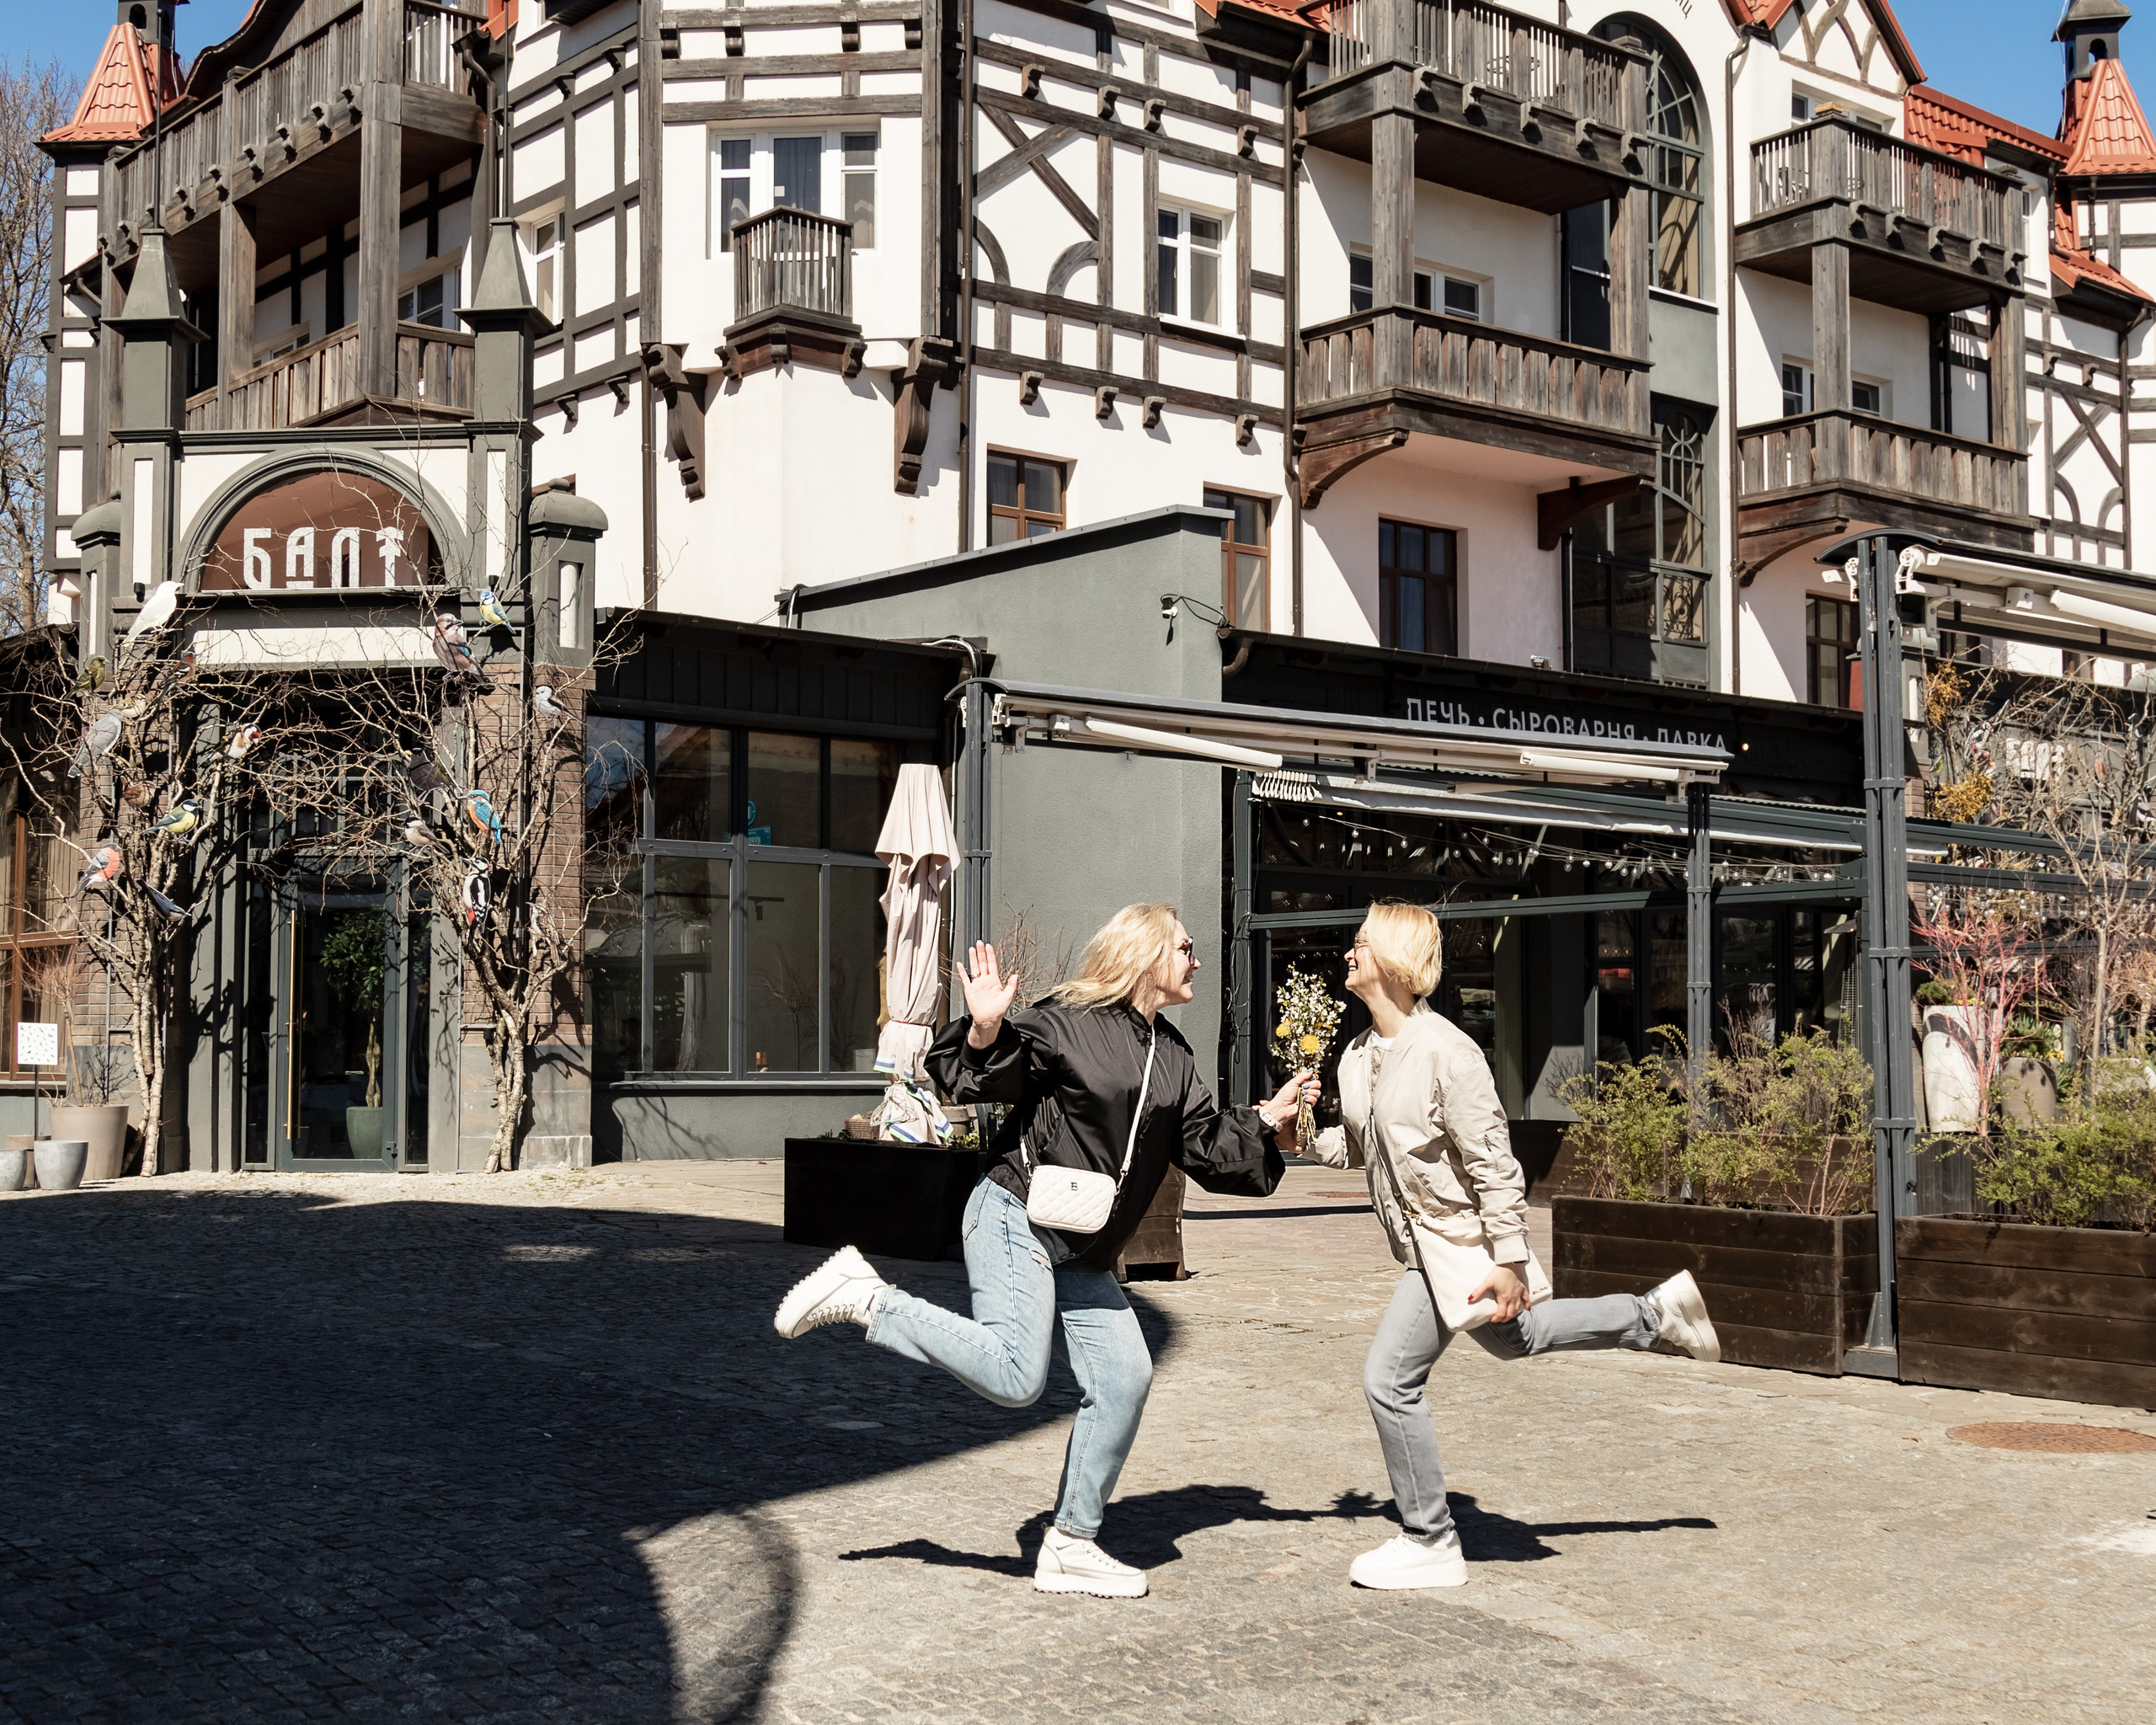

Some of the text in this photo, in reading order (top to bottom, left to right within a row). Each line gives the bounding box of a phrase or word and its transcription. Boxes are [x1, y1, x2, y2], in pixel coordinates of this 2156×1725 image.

[243, 526, 404, 589] БАЛТ
[1407, 698, 1470, 726] ПЕЧЬ
[1492, 708, 1635, 740] СЫРОВАРНЯ
